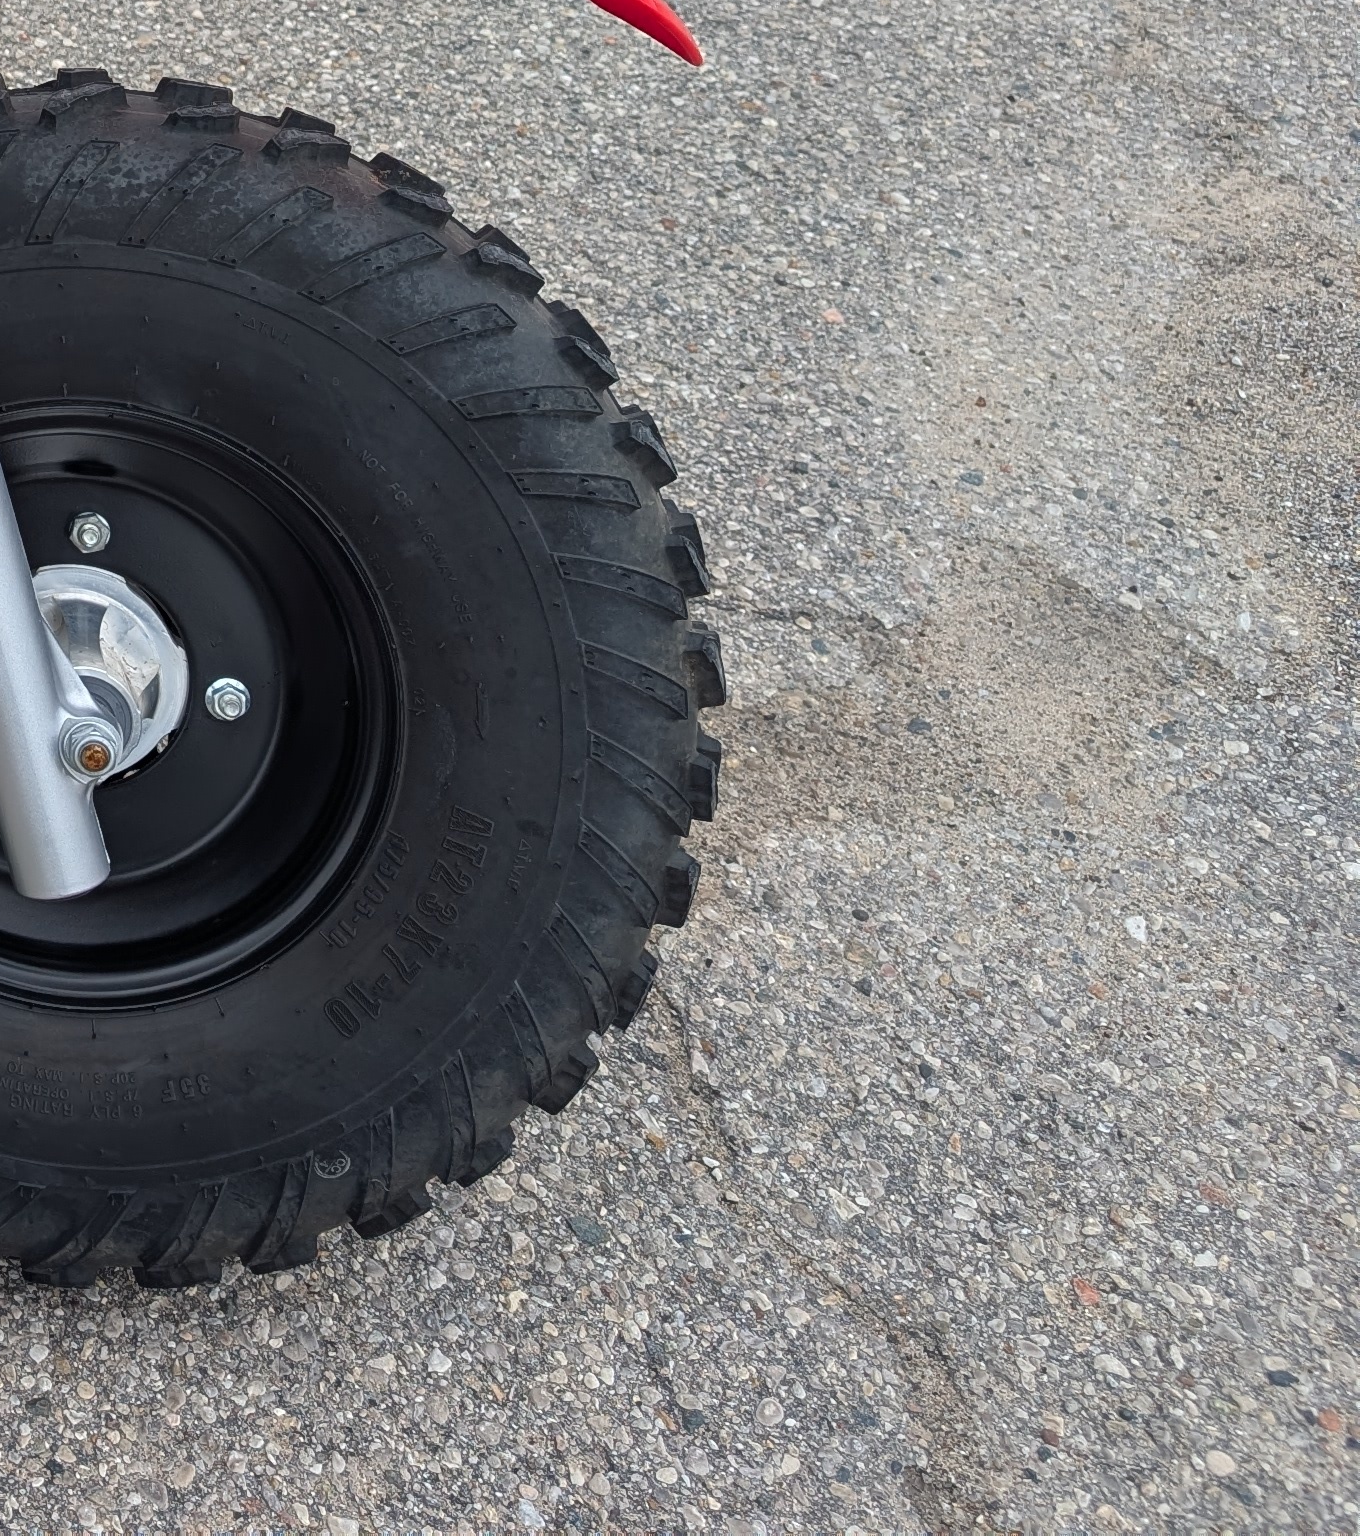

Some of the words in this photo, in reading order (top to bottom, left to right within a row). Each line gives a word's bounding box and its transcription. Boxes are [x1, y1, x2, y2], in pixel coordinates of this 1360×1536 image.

[357, 446, 388, 481] NOT
[449, 591, 474, 625] USE
[321, 804, 495, 1040] AT23X7-10
[7, 1061, 24, 1077] TO
[34, 1066, 63, 1083] MAX
[160, 1073, 211, 1104] 35F
[9, 1094, 73, 1118] RATING
[87, 1103, 120, 1120] PLY
[132, 1104, 143, 1119] 6
